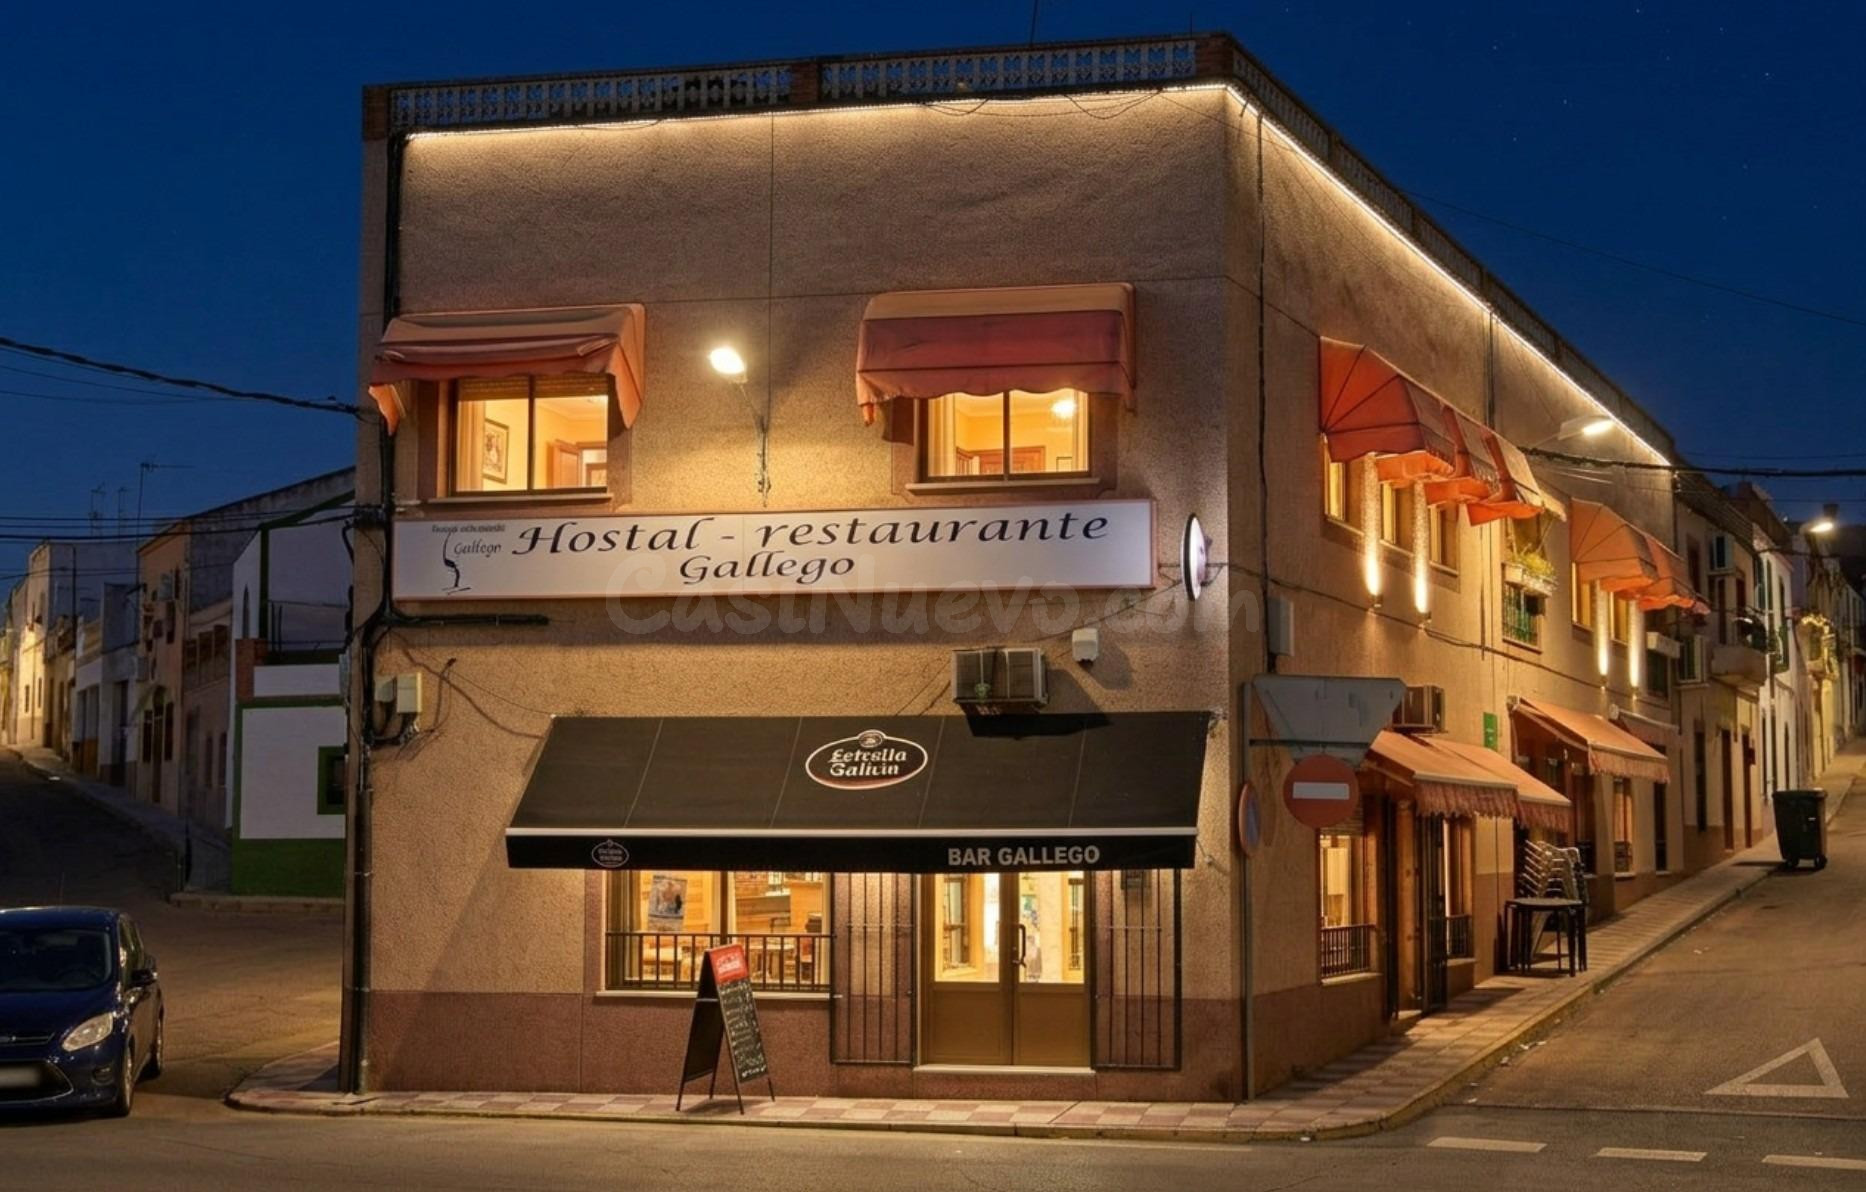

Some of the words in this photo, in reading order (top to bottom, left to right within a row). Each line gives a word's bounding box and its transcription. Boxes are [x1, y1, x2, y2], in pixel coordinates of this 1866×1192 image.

[512, 517, 714, 555] Hostal
[755, 511, 1109, 549] restaurante
[680, 551, 856, 585] Gallego
[948, 848, 992, 866] BAR
[997, 845, 1100, 866] GALLEGO
